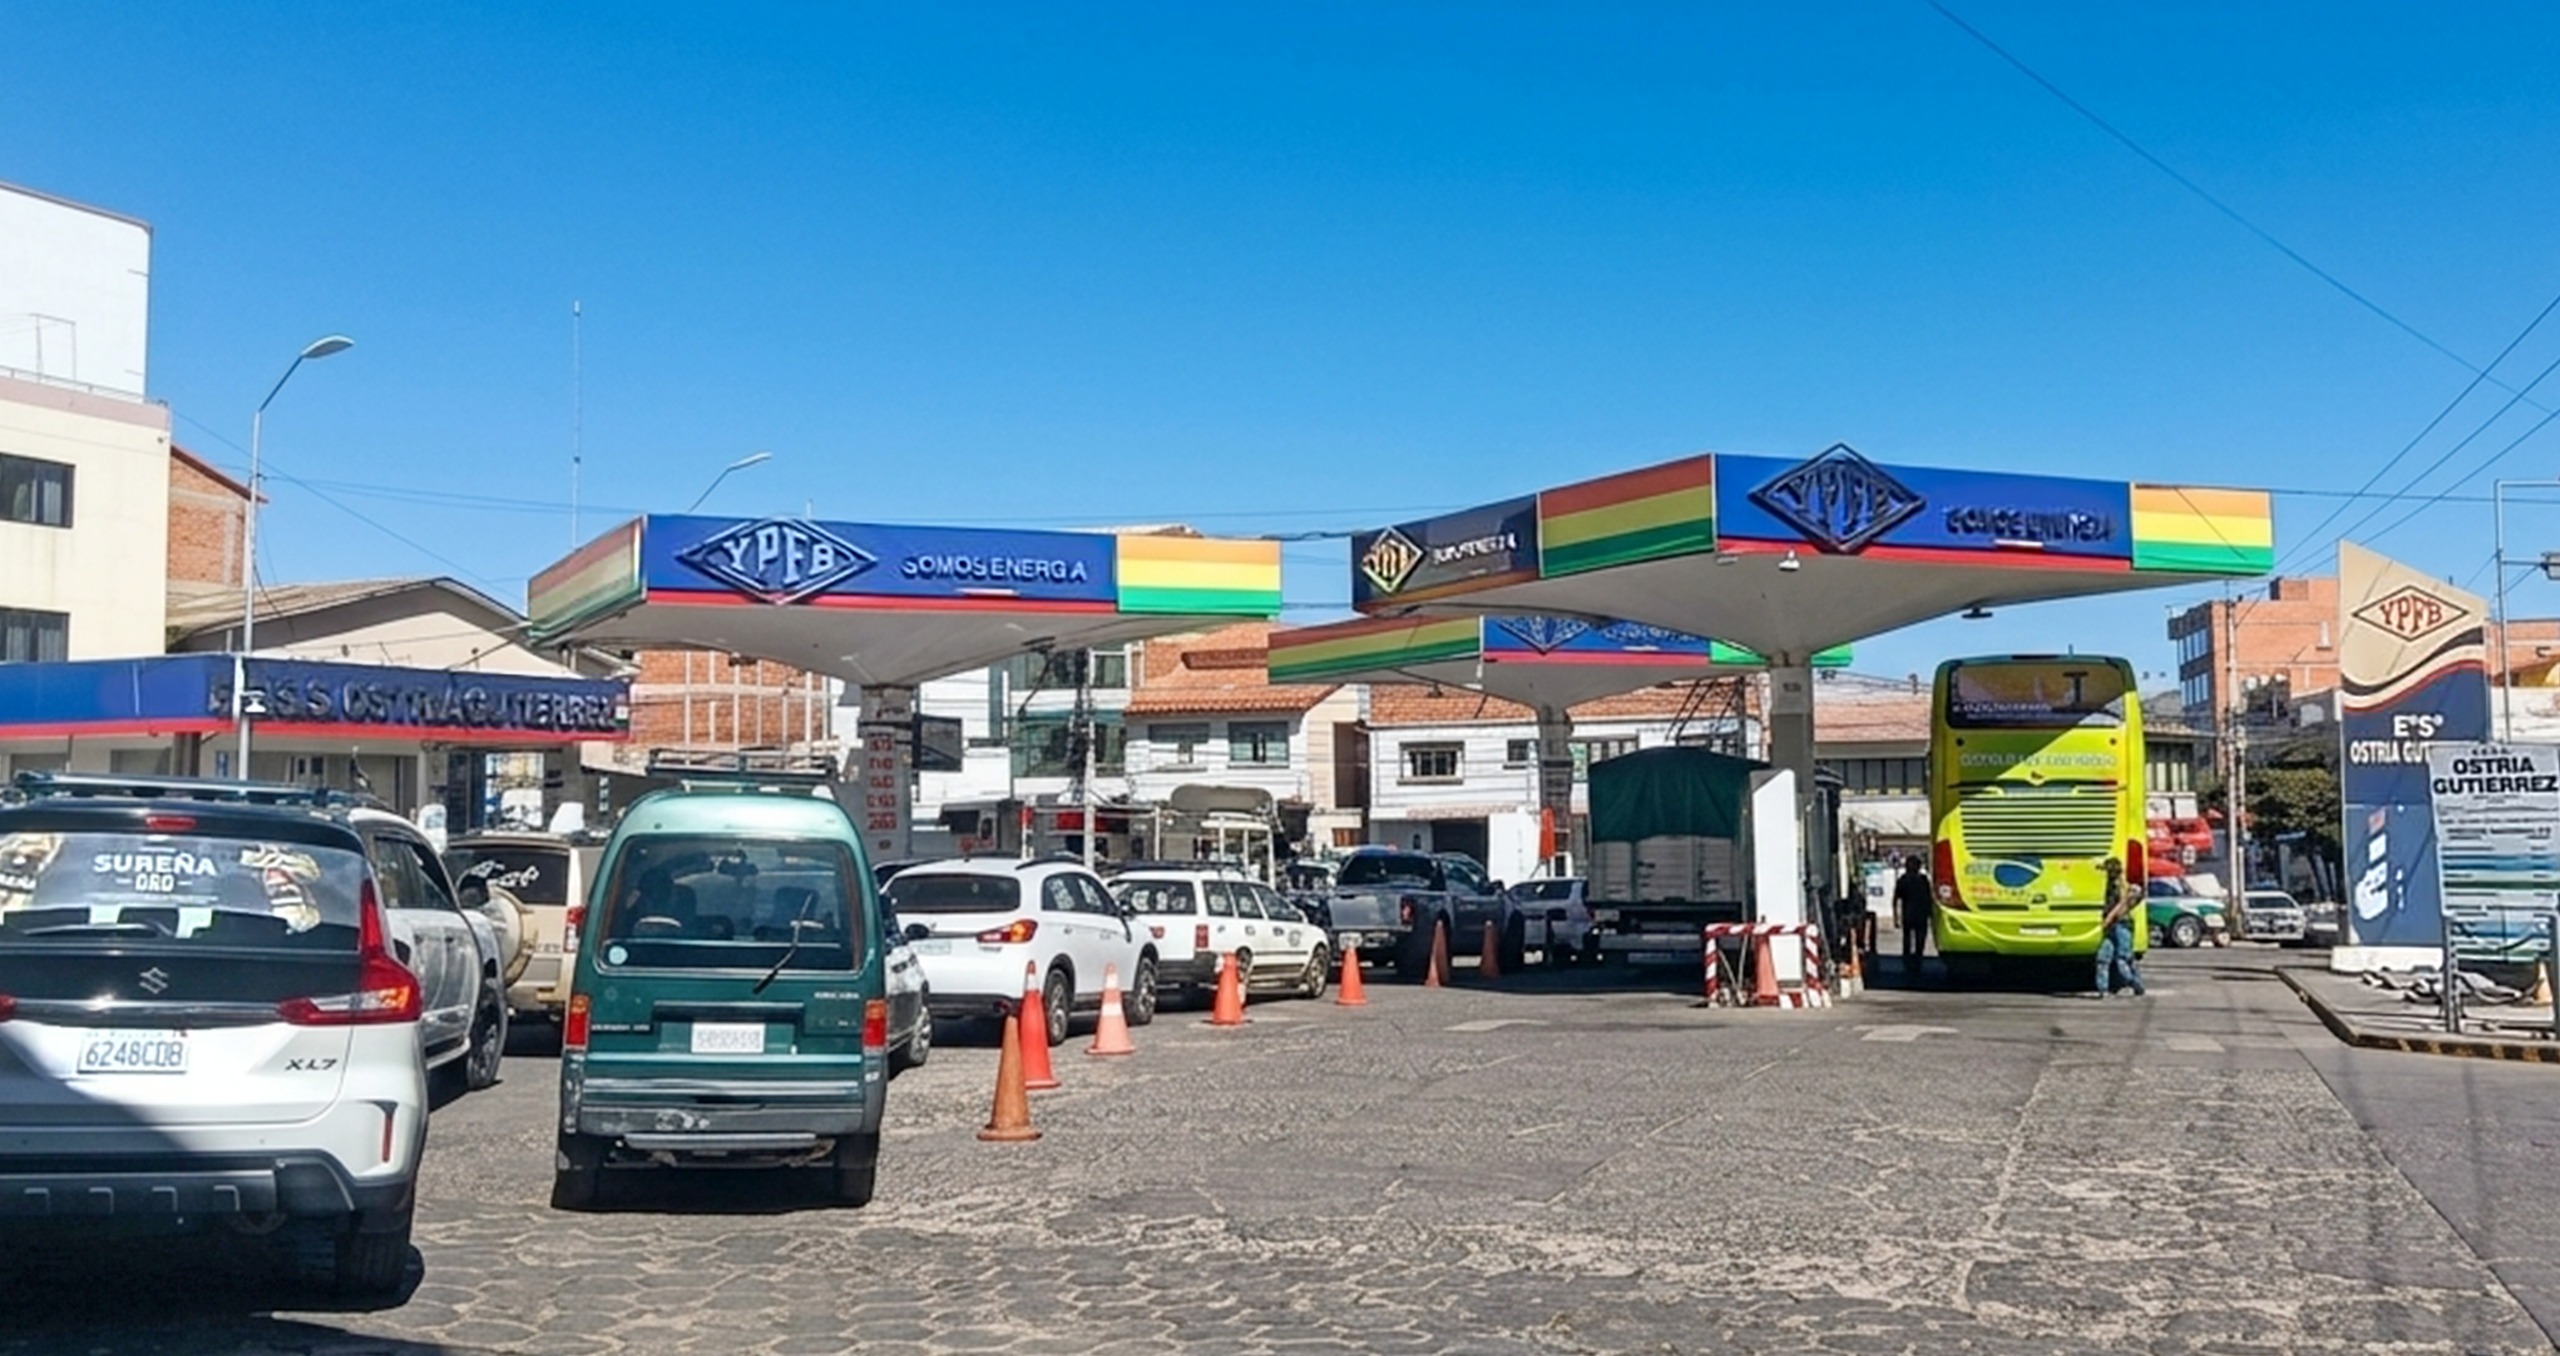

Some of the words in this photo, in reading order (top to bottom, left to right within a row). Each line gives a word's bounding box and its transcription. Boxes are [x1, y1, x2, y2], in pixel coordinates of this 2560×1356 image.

[723, 525, 836, 585] YPFB
[902, 555, 987, 577] SOMOS
[990, 557, 1088, 582] ENERGA
[2379, 594, 2443, 633] YPFB
[2350, 740, 2400, 764] OSTRIA
[2452, 757, 2535, 775] OSTRIA
[2432, 776, 2559, 794] GUTIERREZ
[93, 852, 217, 876] SUREÑA
[135, 874, 174, 891] ORO
[285, 1059, 338, 1071] XL7
